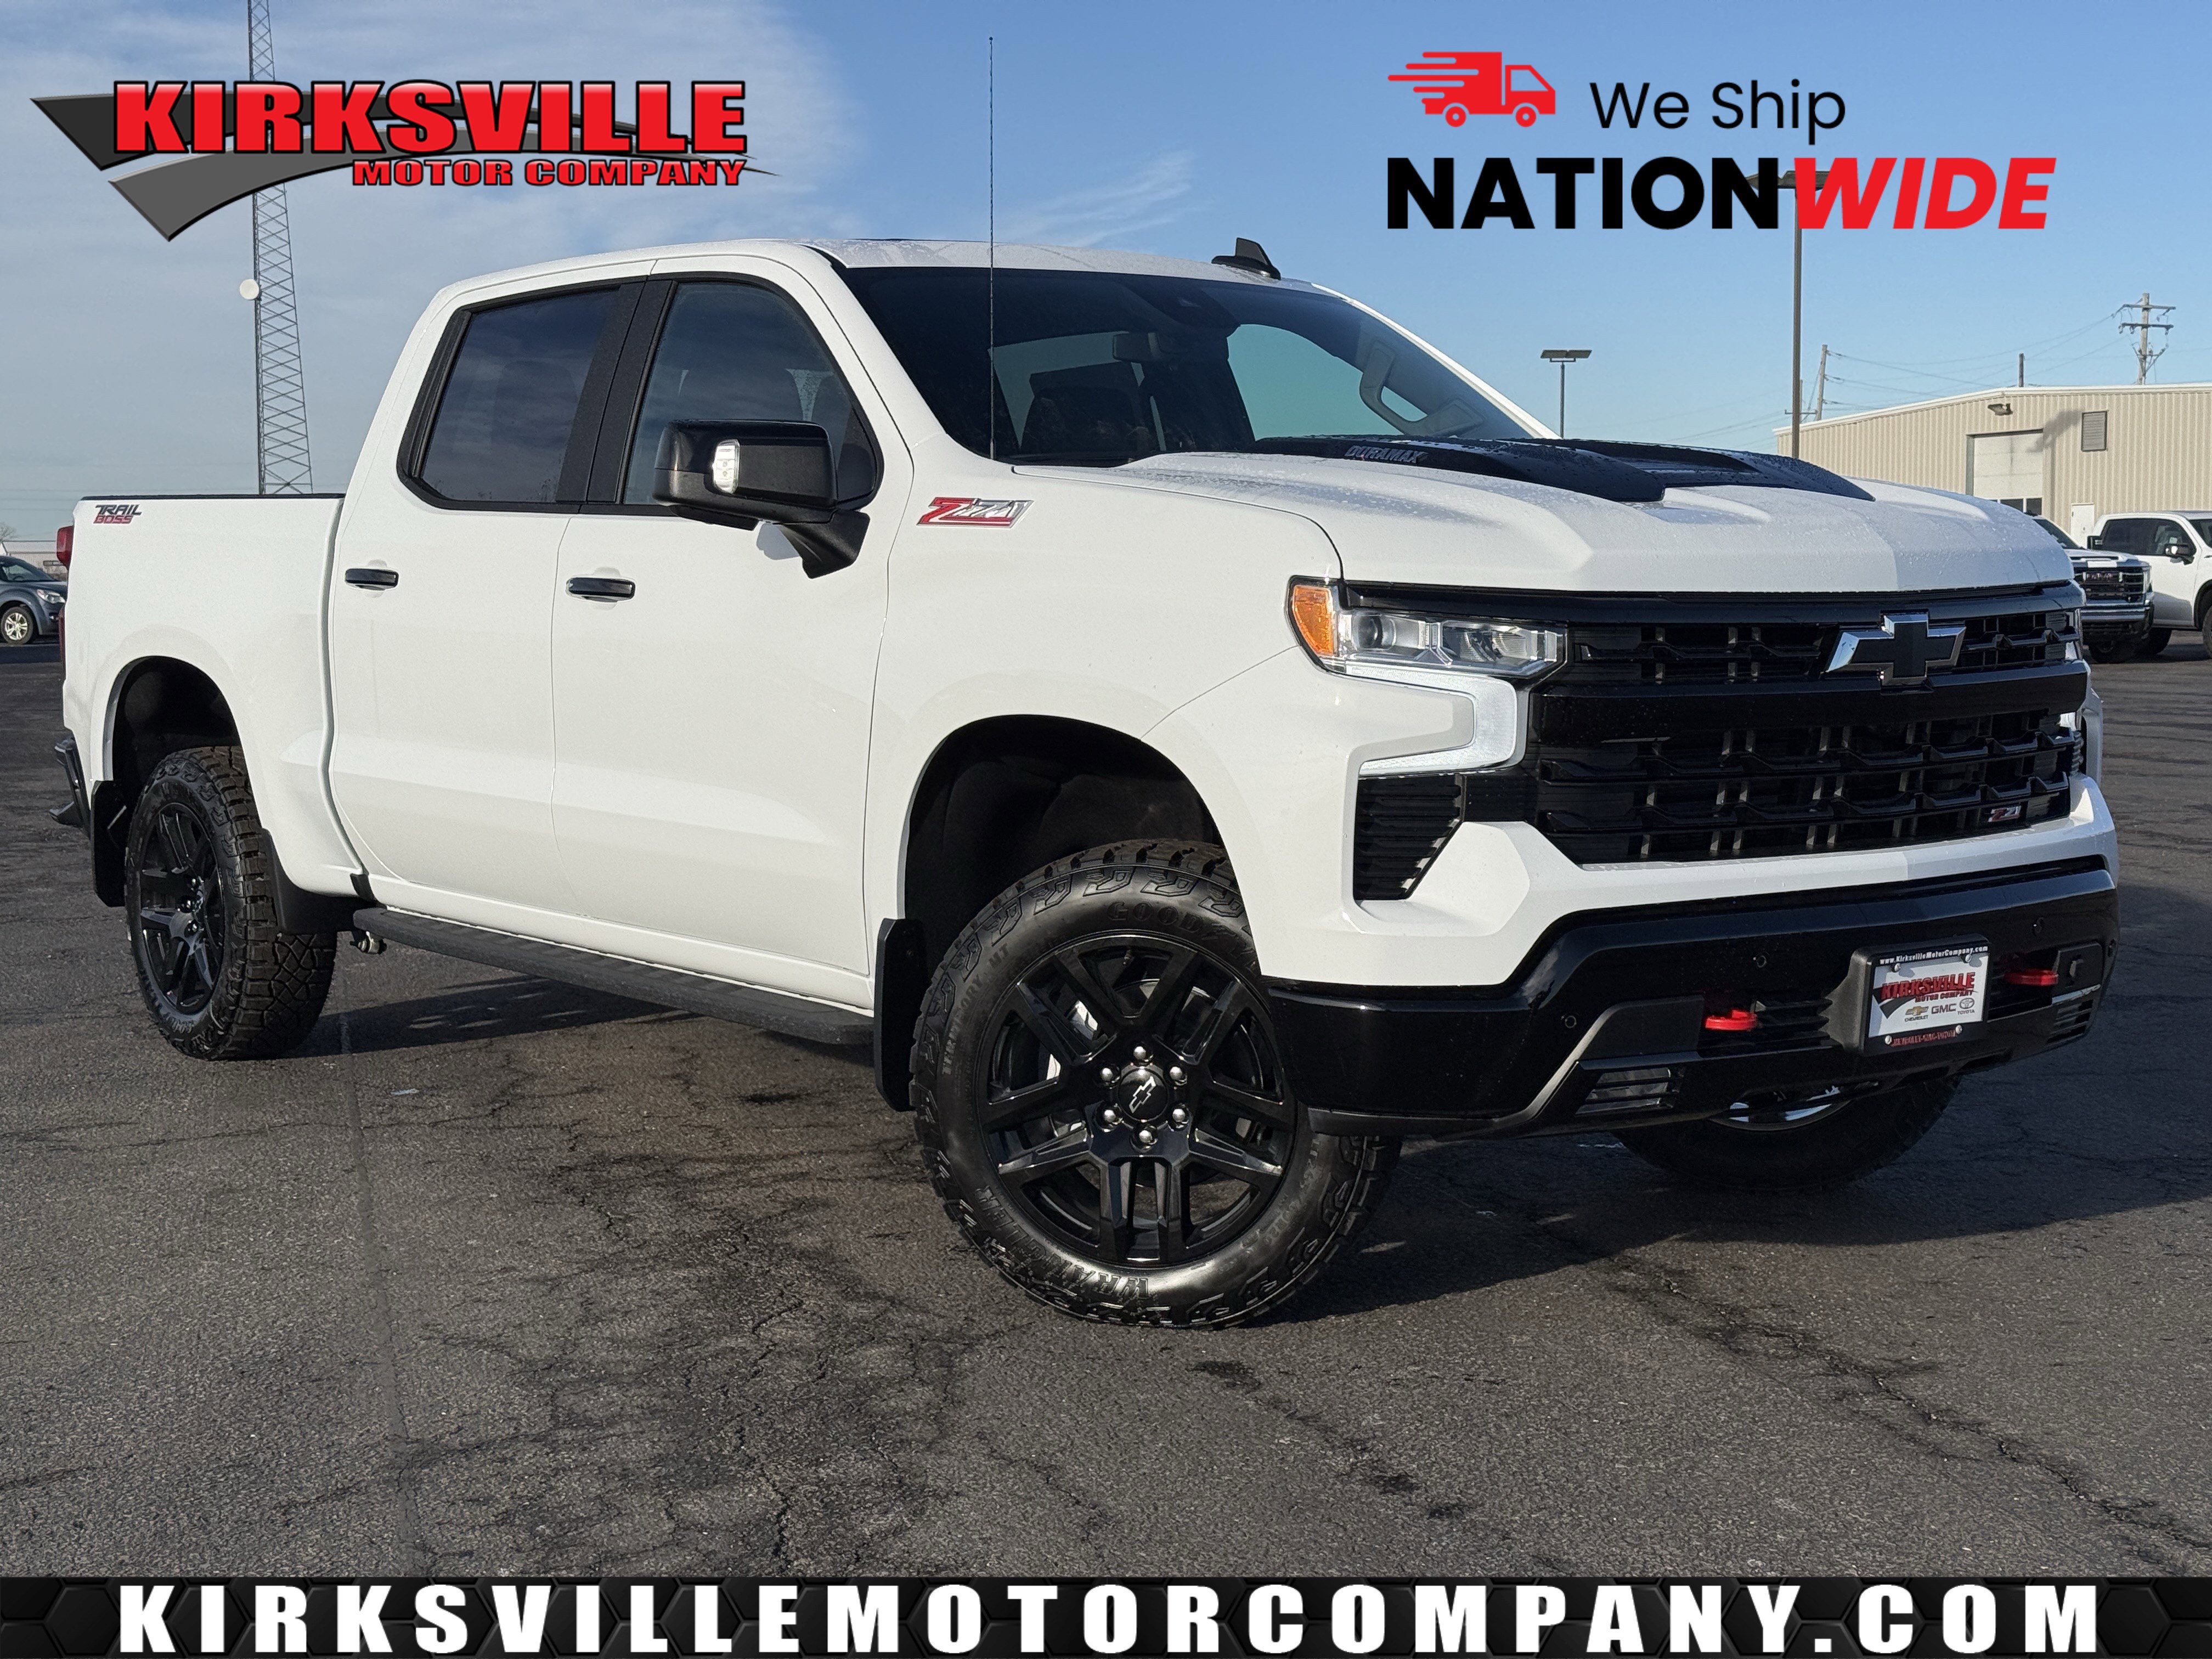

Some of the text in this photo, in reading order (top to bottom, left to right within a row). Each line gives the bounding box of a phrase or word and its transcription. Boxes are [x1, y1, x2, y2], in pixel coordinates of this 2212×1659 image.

[1344, 445, 1428, 464] DURAMAX
[95, 504, 142, 515] TRAIL
[916, 496, 1034, 528] Z71
[93, 515, 134, 524] BOSS
[1988, 805, 2022, 823] Z71
[1880, 946, 1988, 964] www.KirksvilleMotorCompany.com
[1880, 972, 1976, 1000] KIRKSVILLE
[1915, 989, 1974, 1003] MOTOR COMPANY
[1931, 1003, 1957, 1014] GMC
[973, 1183, 1152, 1300] WRANGLER
